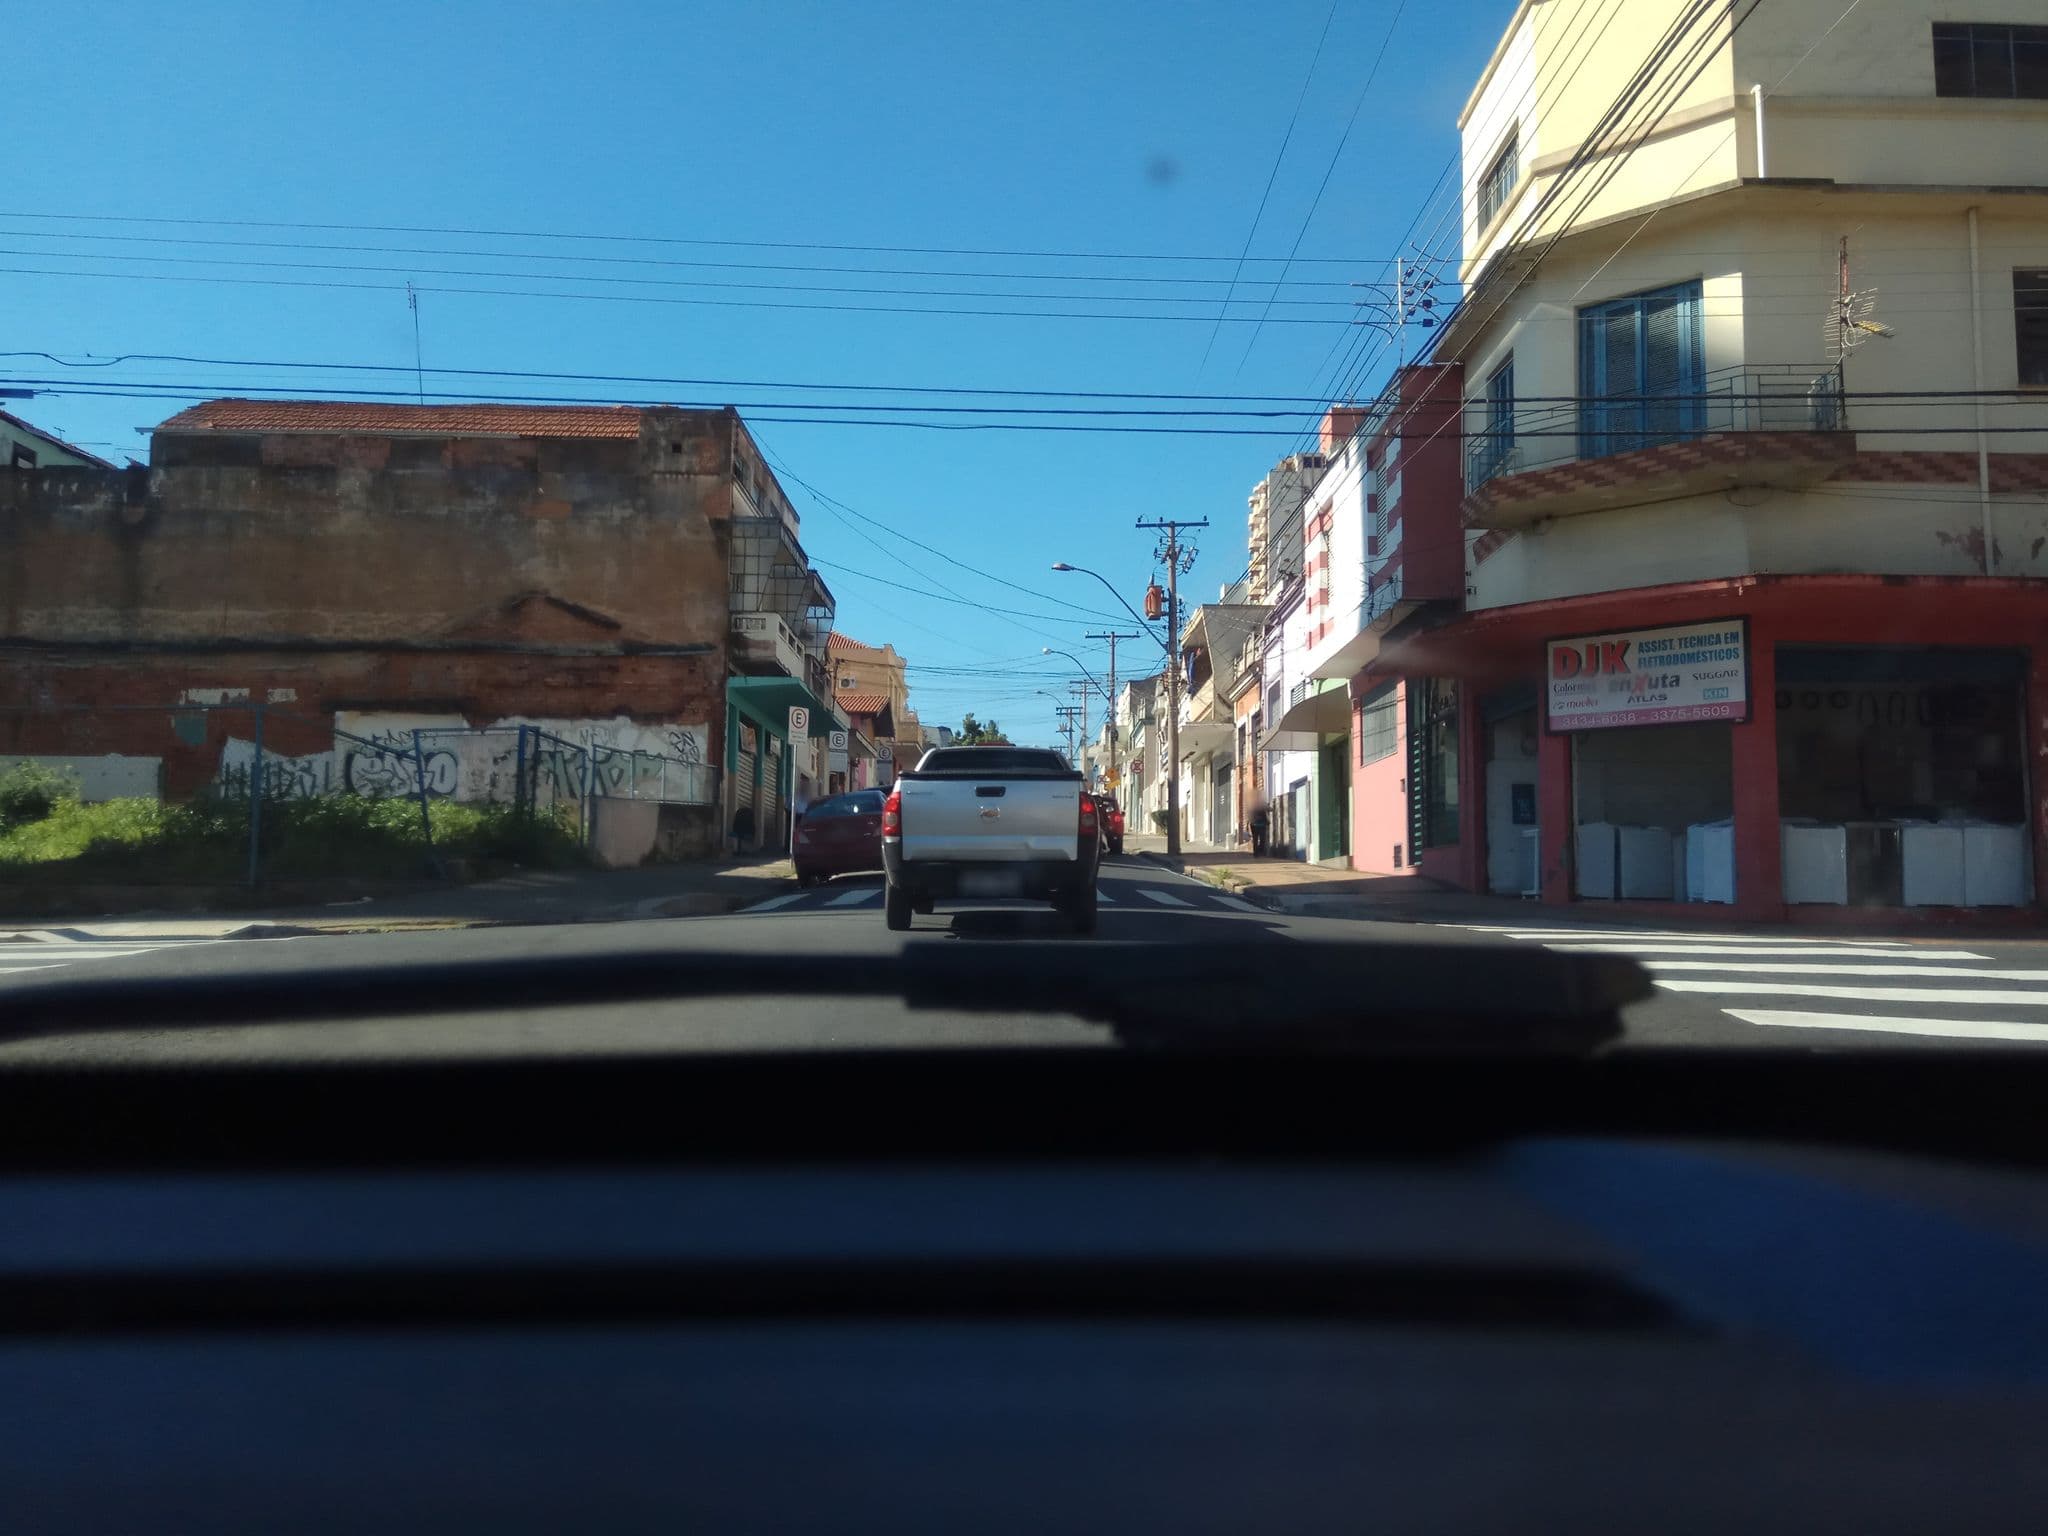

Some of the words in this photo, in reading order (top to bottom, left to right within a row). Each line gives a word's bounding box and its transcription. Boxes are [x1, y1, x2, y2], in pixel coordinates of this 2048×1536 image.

[1723, 631, 1740, 644] EM
[1552, 640, 1631, 680] DJK
[1691, 669, 1739, 682] SUGGAR
[1627, 693, 1668, 705] ATLAS
[796, 713, 802, 725] E
[1651, 705, 1729, 722] 3375-5609
[835, 735, 842, 745] E
